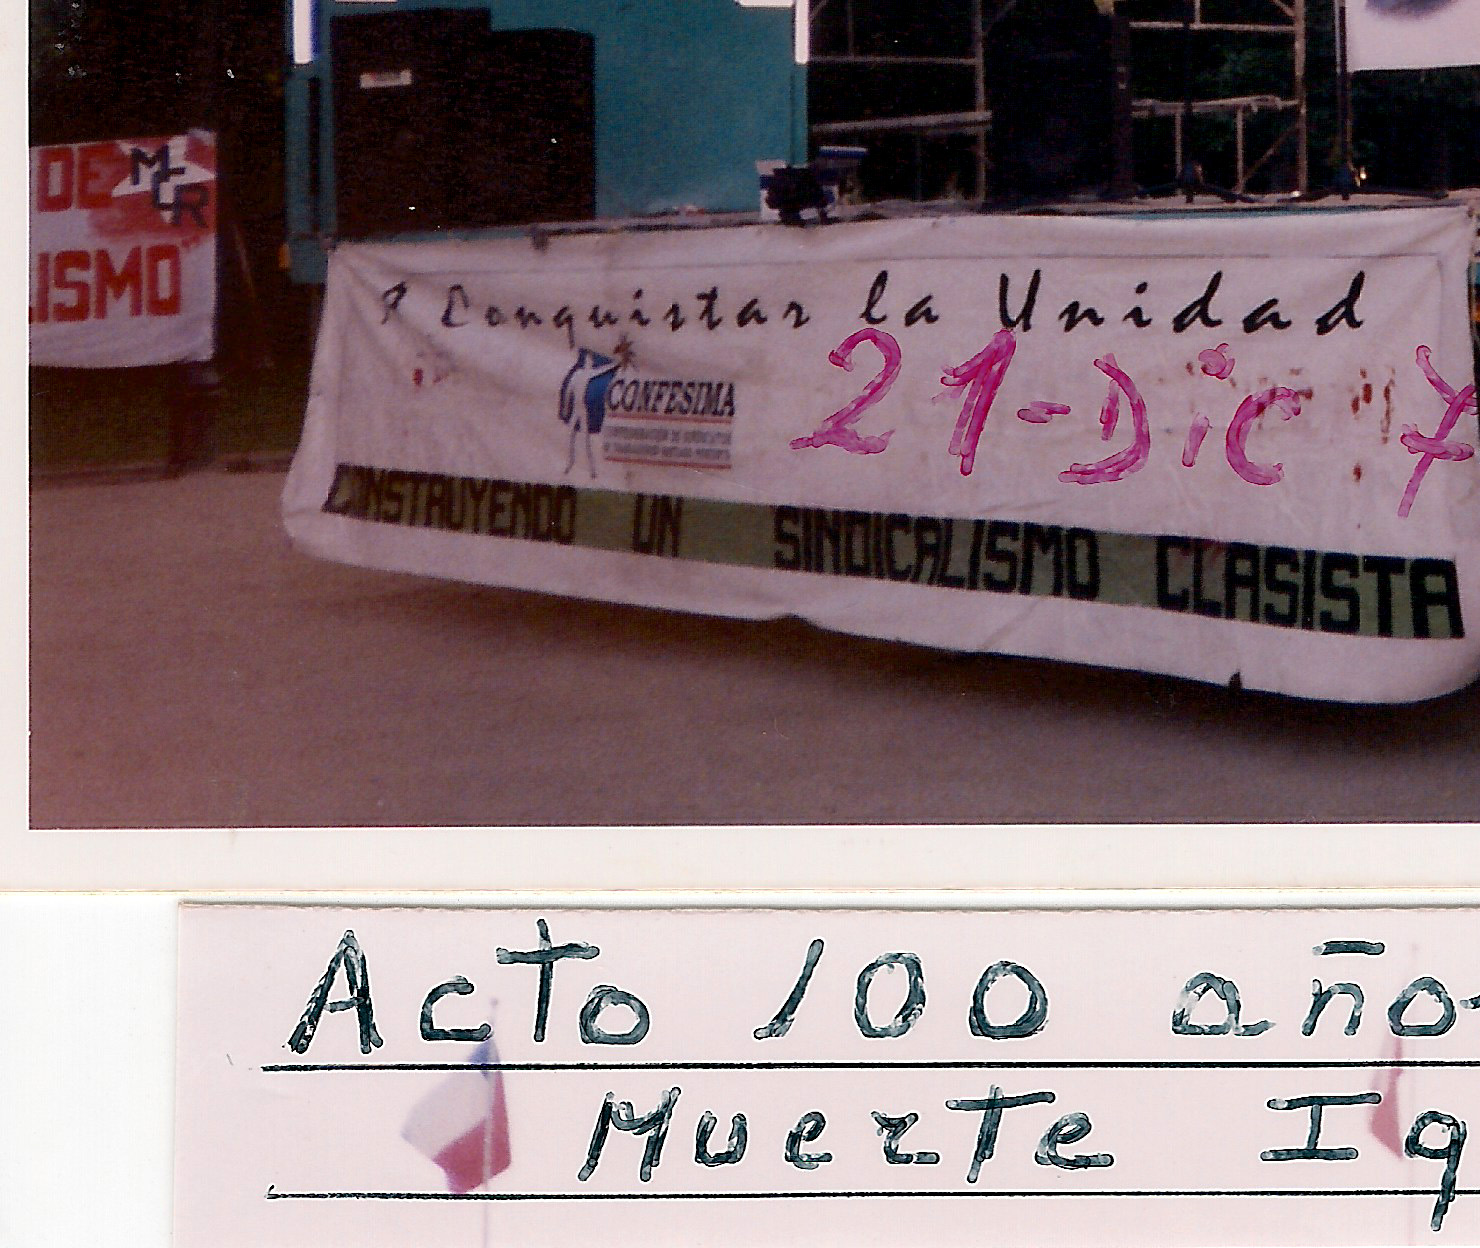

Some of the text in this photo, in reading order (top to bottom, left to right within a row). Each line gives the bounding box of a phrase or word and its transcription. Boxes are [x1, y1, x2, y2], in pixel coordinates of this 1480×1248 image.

[37, 145, 122, 212] DE
[440, 282, 812, 349] Conquistar
[859, 268, 940, 327] la
[998, 267, 1366, 335] Unidad
[607, 378, 736, 418] CONFESIMA
[321, 463, 1466, 640] CONSTRUYENDO UN SINDICALISMO CLASISTA
[755, 938, 1048, 1041] 100
